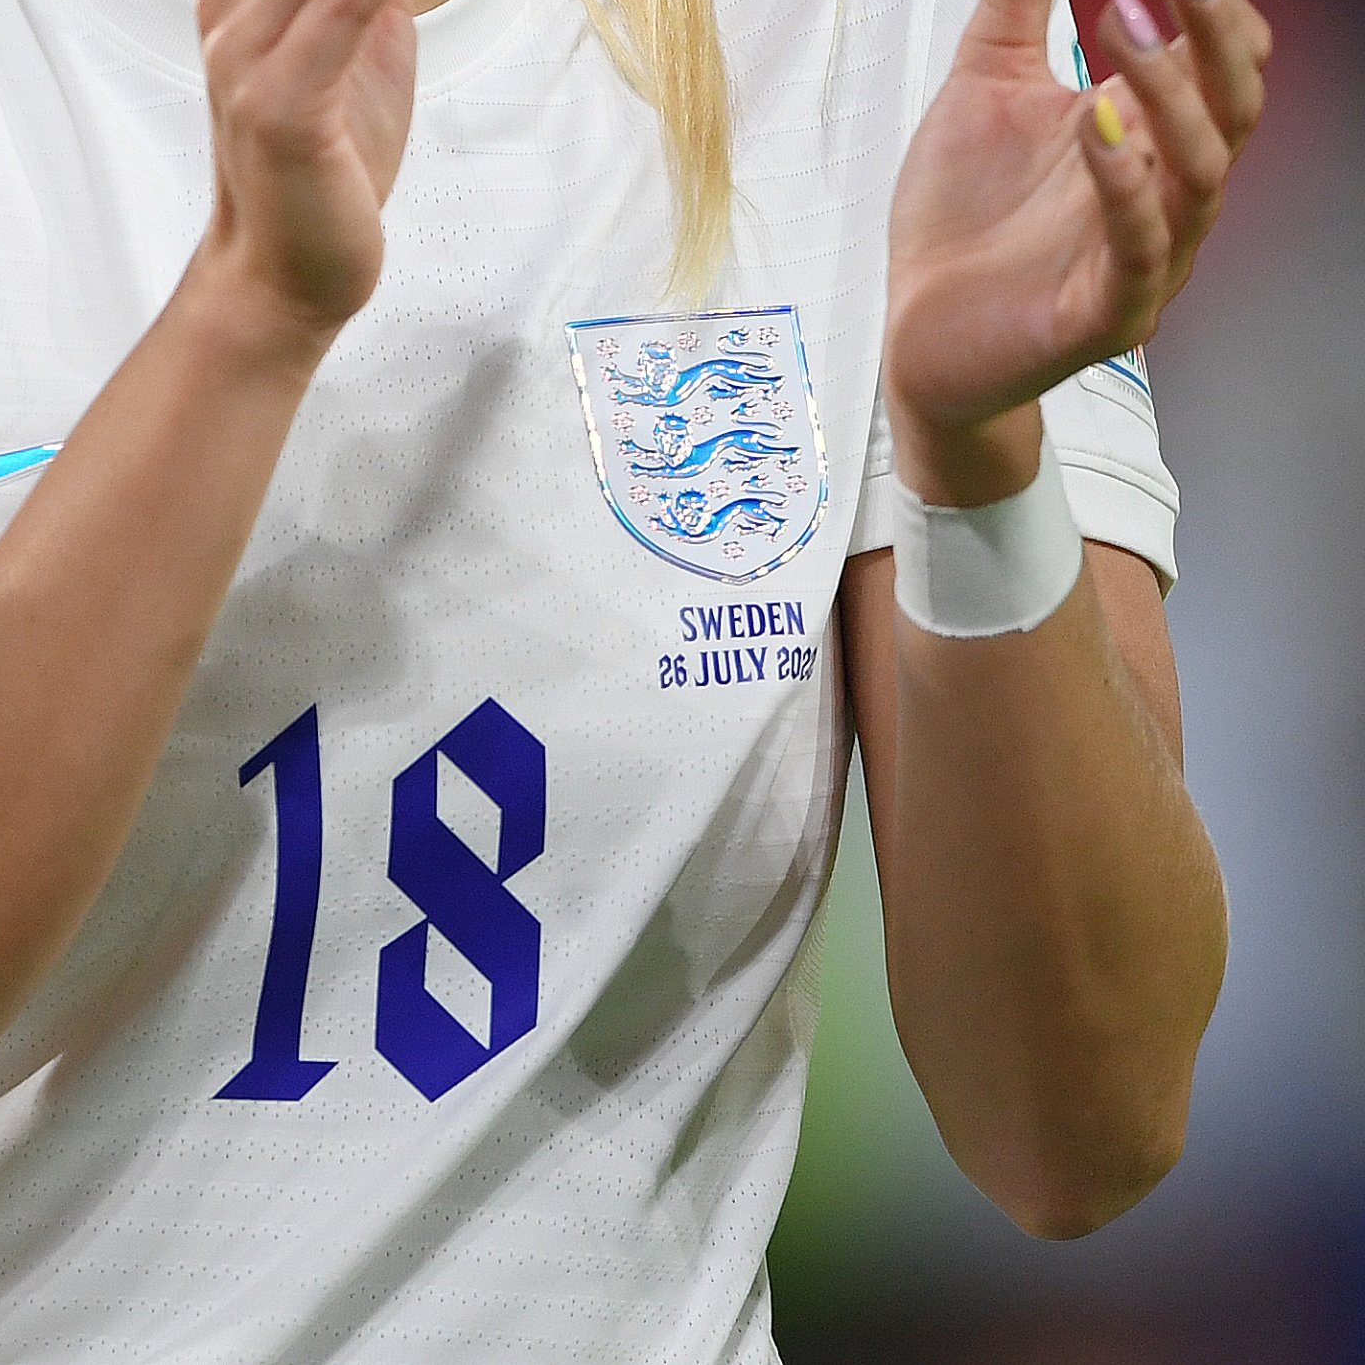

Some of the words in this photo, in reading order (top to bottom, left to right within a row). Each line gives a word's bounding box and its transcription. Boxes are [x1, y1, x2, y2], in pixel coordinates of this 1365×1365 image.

[679, 601, 806, 642] SWEDEN
[658, 654, 688, 689] 26
[695, 646, 768, 687] JULY
[211, 696, 547, 1104] 18
